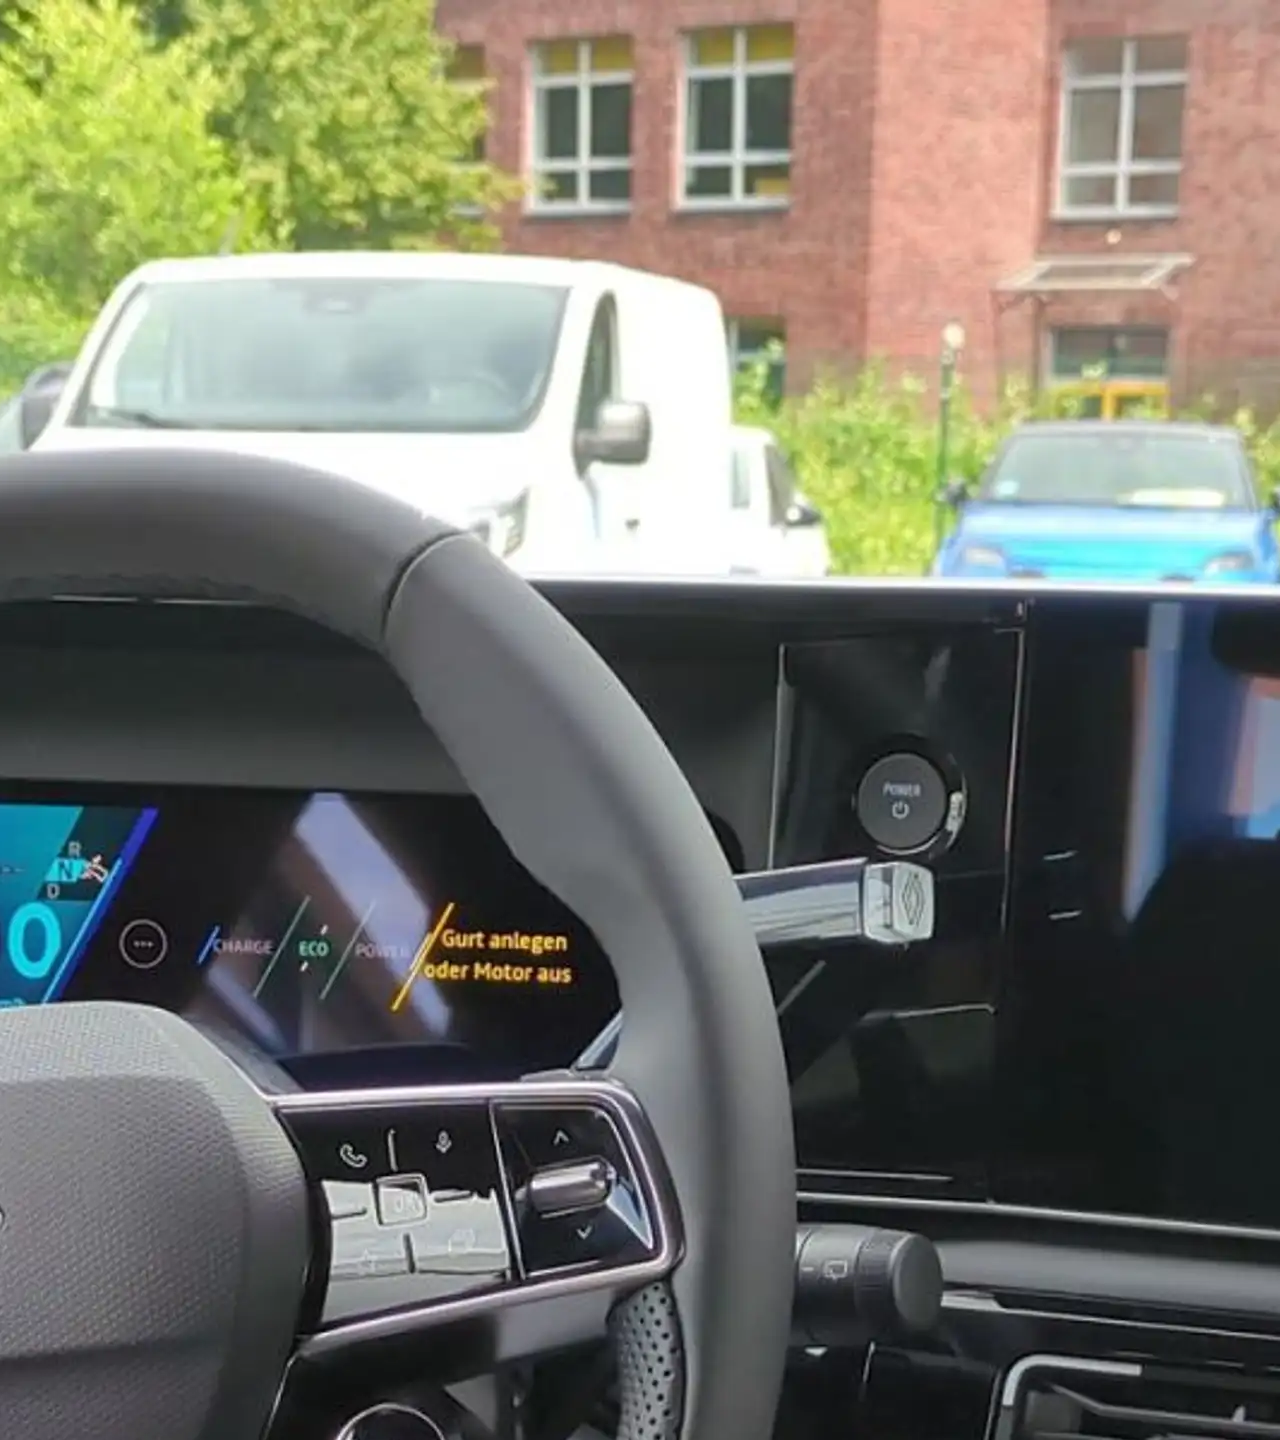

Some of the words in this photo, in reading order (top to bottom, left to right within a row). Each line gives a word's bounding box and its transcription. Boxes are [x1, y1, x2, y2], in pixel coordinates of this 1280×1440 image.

[213, 939, 273, 955] CHARGE
[299, 941, 330, 957] ECO
[441, 929, 486, 948] Gurt
[489, 930, 568, 956] anlegen
[423, 960, 470, 980] oder
[474, 962, 533, 982] Motor
[537, 967, 572, 983] aus
